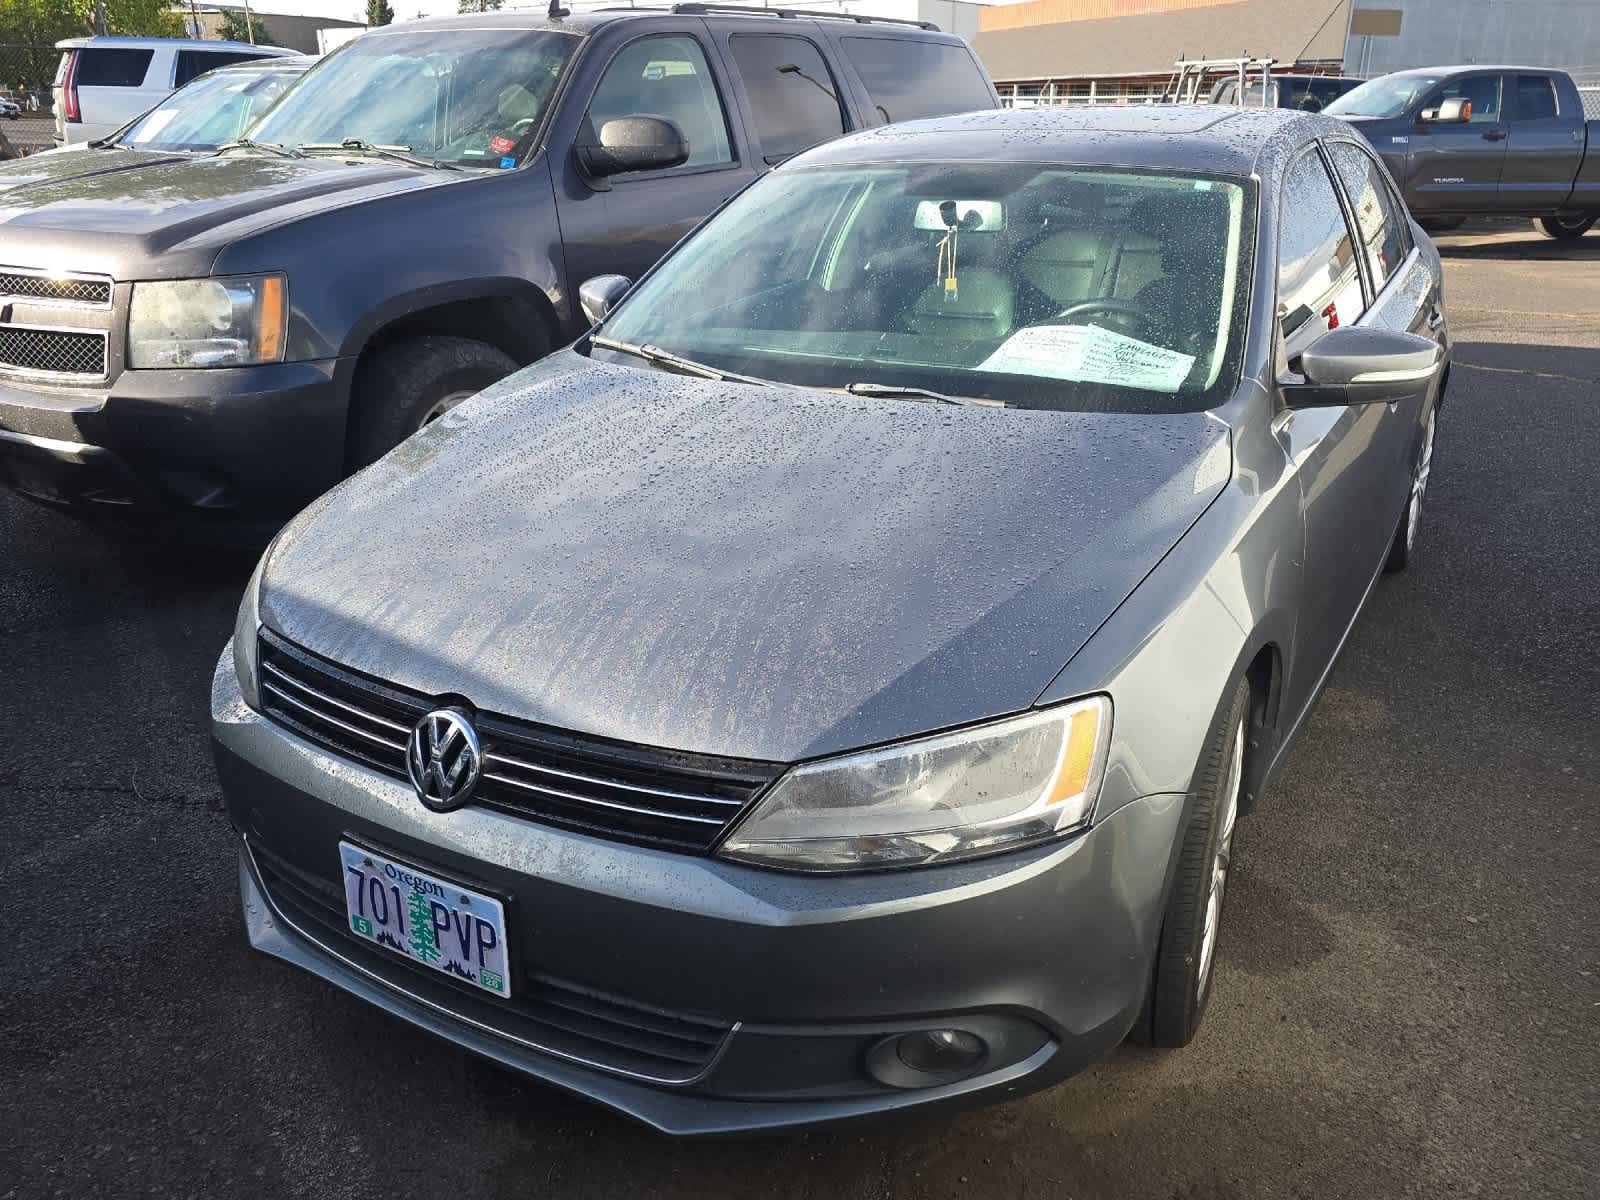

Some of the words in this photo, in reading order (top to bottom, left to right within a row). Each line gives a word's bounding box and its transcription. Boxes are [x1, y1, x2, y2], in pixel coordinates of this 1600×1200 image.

[384, 863, 447, 898] Oregon
[347, 866, 405, 935] 701
[430, 900, 497, 968] PVP
[359, 919, 367, 933] 5
